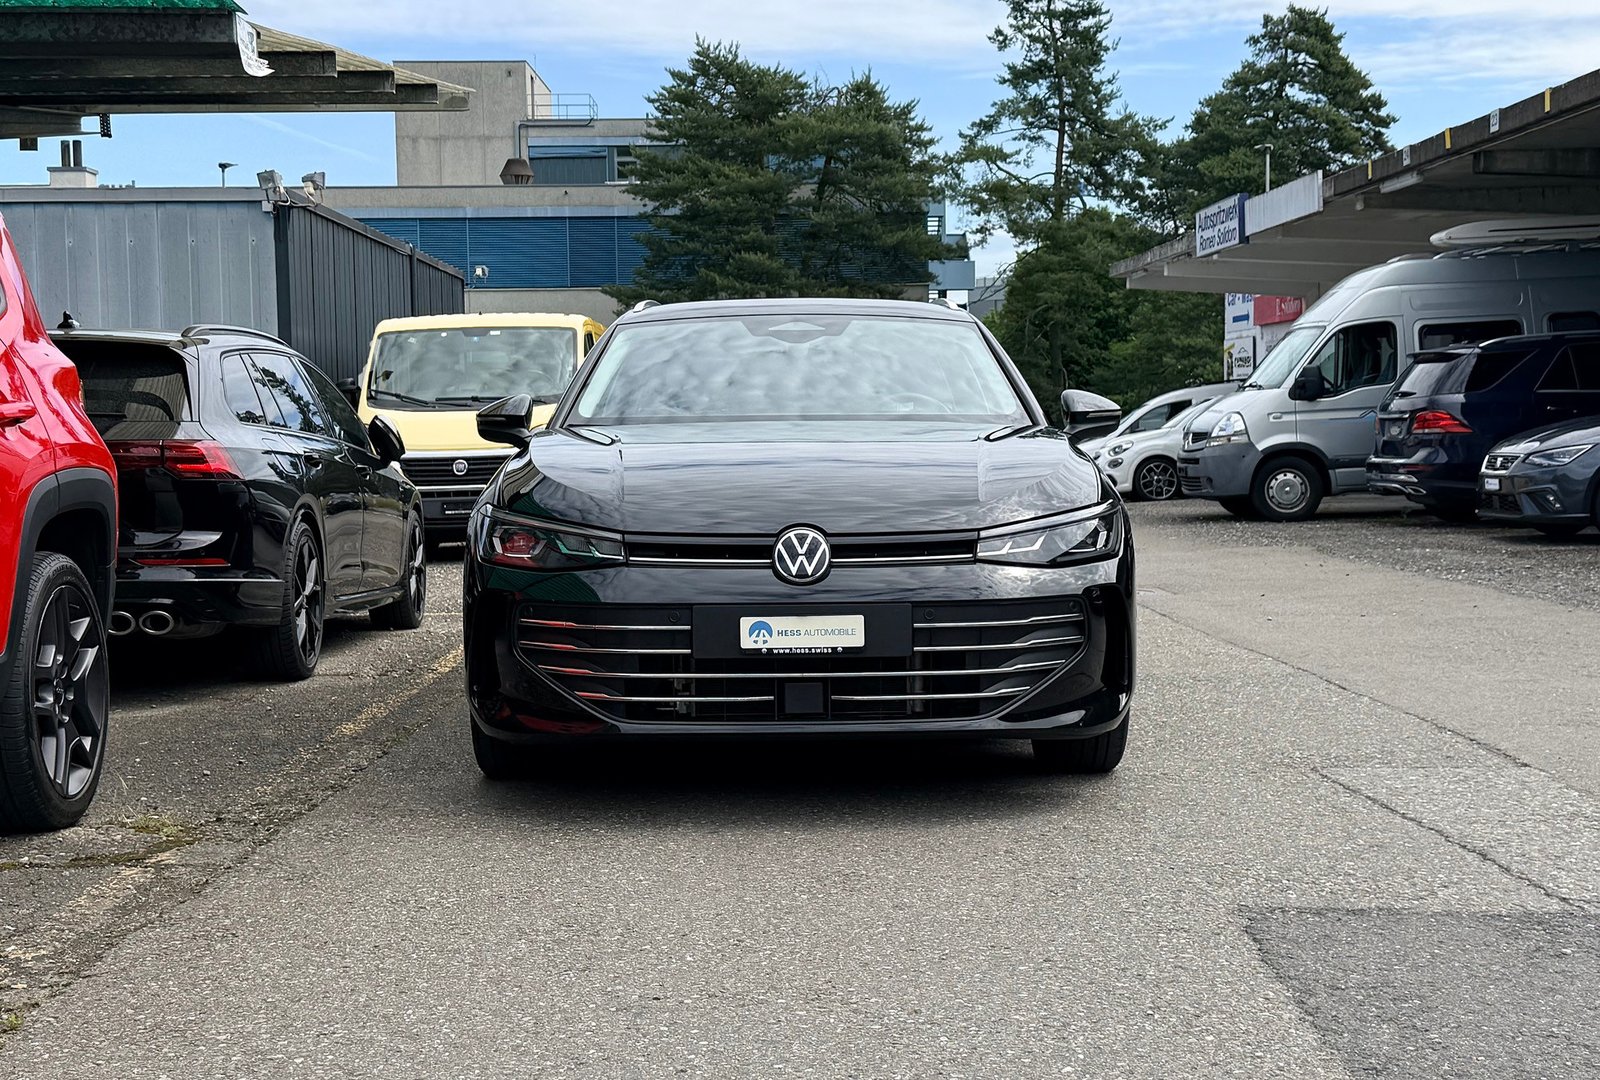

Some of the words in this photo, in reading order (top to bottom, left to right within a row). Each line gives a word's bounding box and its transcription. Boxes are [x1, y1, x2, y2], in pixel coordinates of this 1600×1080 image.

[776, 629, 802, 637] HESS
[803, 628, 857, 637] AUTOMOBILE
[772, 646, 833, 654] www.hess.swiss
